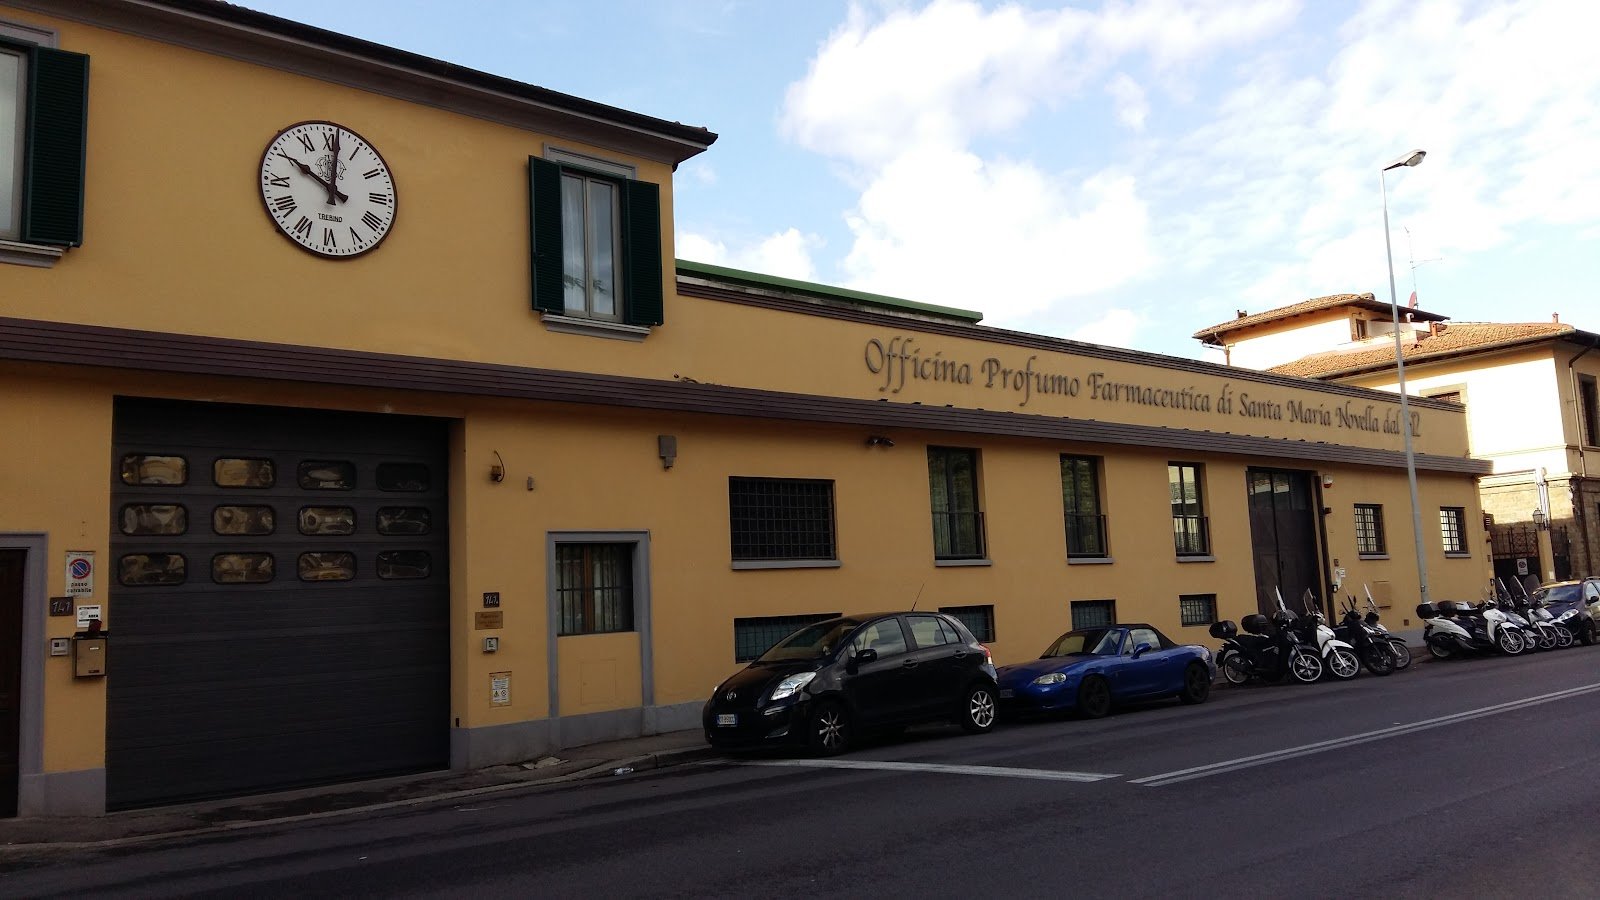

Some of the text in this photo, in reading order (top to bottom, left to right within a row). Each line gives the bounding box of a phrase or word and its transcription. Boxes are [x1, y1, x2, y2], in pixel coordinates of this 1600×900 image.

[349, 146, 360, 161] I
[362, 168, 381, 180] II
[368, 192, 388, 206] III
[293, 215, 313, 239] VII
[349, 226, 363, 245] V
[323, 227, 337, 248] VI
[865, 336, 972, 393] Officina
[981, 356, 1080, 406] Profumo
[1087, 372, 1212, 413] Farmaceutica
[1217, 383, 1234, 415] di
[1239, 393, 1282, 420] Santa
[1287, 400, 1331, 427] Maria
[1336, 402, 1379, 432] Novella
[1383, 408, 1401, 434] dal
